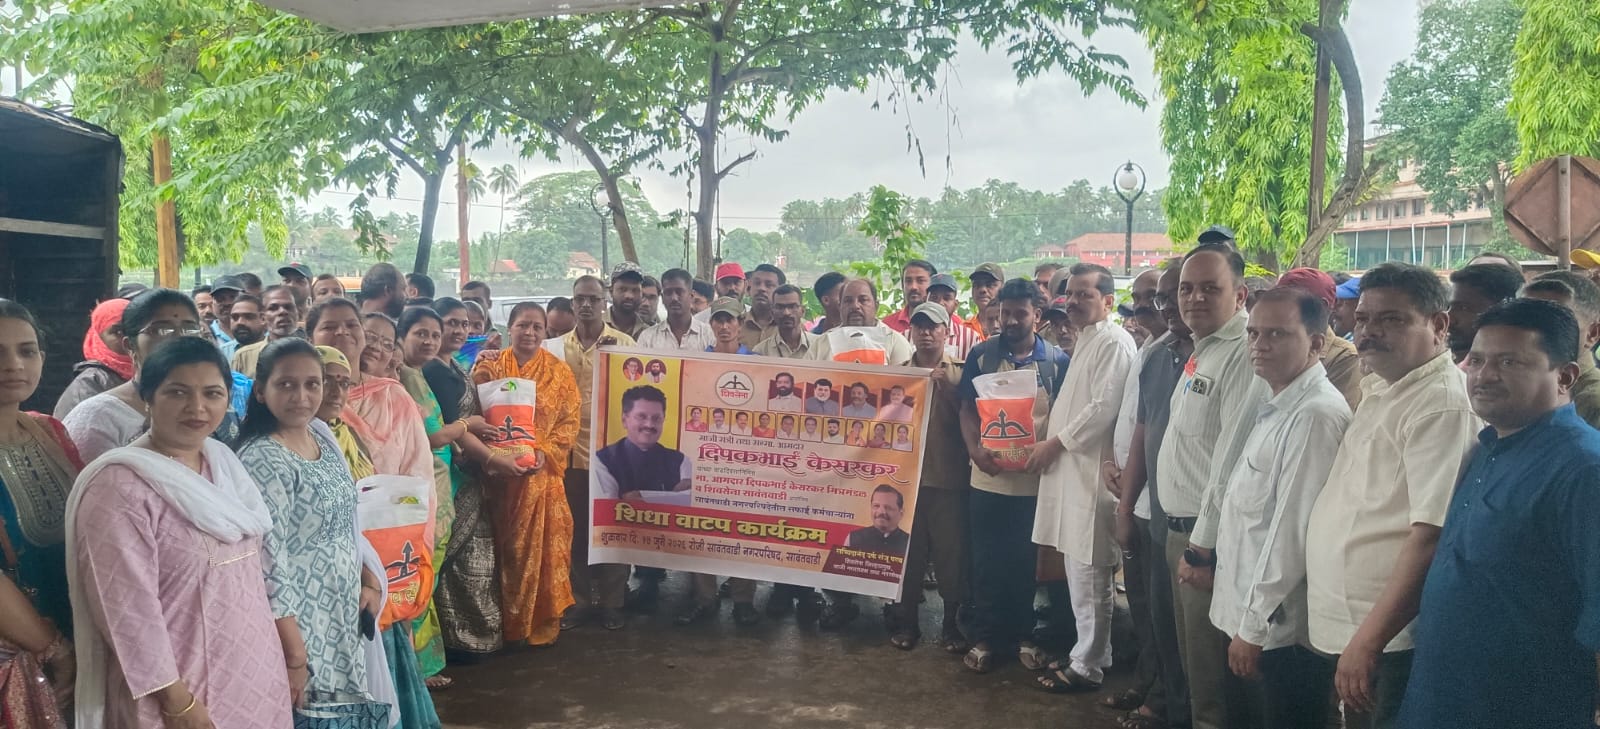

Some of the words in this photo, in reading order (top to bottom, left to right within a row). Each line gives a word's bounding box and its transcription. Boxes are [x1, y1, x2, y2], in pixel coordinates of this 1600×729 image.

[721, 389, 748, 398] शिवसेना
[698, 442, 806, 476] दिपकभाई
[806, 452, 911, 484] केसरकर
[704, 484, 740, 496] शिवसेना
[743, 489, 788, 500] सावंतवाडी
[712, 476, 743, 485] आमदार
[746, 476, 786, 490] दिपकभाई
[789, 480, 824, 492] केसरकर
[614, 502, 671, 526] शिधा
[675, 513, 732, 534] वाटप
[736, 520, 828, 544] कार्यक्रम
[688, 538, 704, 552] रोजी
[707, 540, 740, 555] सावंतवाडी
[786, 550, 822, 565] सावंतवाडी
